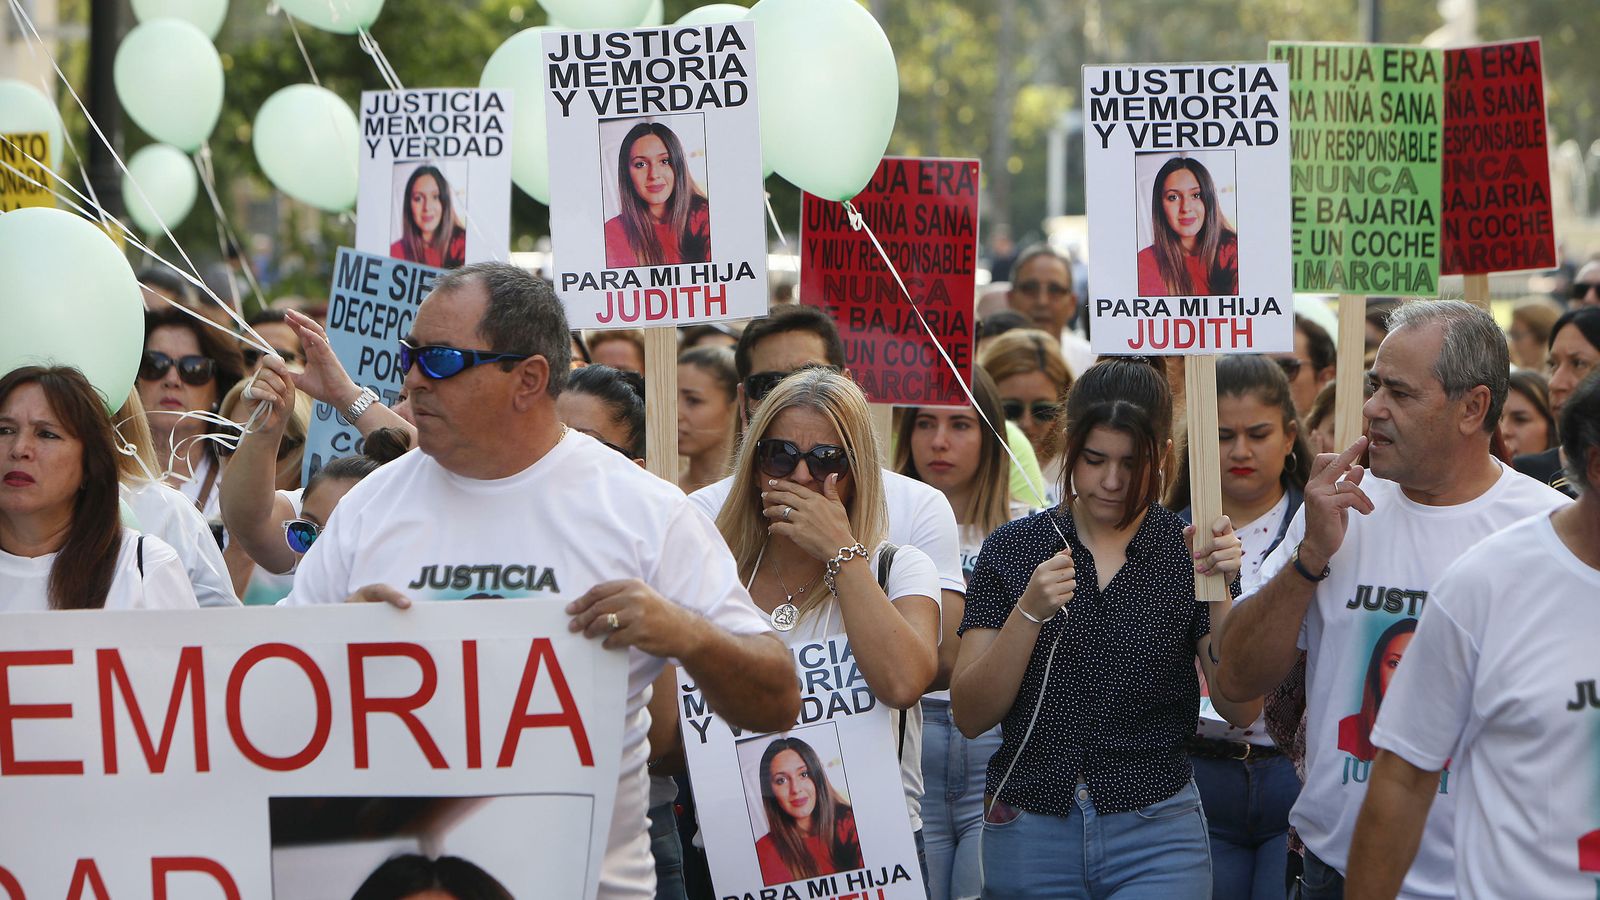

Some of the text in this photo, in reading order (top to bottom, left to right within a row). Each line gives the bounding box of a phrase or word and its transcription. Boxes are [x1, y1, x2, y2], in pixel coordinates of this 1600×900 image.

[548, 25, 746, 61] JUSTICIA
[549, 53, 747, 88] MEMORIA
[1312, 48, 1374, 82] HIJA
[1383, 50, 1438, 83] ERA
[1481, 44, 1539, 79] ERA
[1090, 67, 1279, 95] JUSTICIA
[366, 92, 504, 115] JUSTICIA
[552, 80, 748, 117] Y VERDAD
[1090, 94, 1279, 121] MEMORIA
[1324, 84, 1374, 122] NIÑA
[1380, 92, 1438, 124] SANA
[1482, 82, 1541, 117] SANA
[365, 114, 504, 136] MEMORIA
[1093, 121, 1279, 148] Y VERDAD
[366, 136, 503, 158] Y VERDAD
[1326, 130, 1437, 162] RESPONSABLE
[917, 162, 976, 196] ERA
[1291, 165, 1419, 195] NUNCA
[808, 199, 851, 232] UNA
[914, 204, 973, 237] SANA
[1317, 198, 1434, 226] BAJARIA
[1468, 210, 1550, 240] COCHE
[808, 239, 972, 275] Y MUY RESPONSABLE
[1311, 230, 1343, 256] UN
[1351, 231, 1435, 258] COCHE
[337, 252, 382, 296] ME
[561, 261, 756, 291] PARA MI HIJA
[1303, 260, 1434, 292] MARCHA
[596, 284, 727, 323] JUDITH
[824, 275, 952, 306] NUNCA
[331, 294, 417, 343] DECEPC
[850, 307, 968, 336] BAJARIA
[1096, 297, 1282, 317] PARA MI HIJA
[1127, 318, 1252, 349] JUDITH
[844, 339, 967, 369] UN COCHE
[408, 564, 560, 593] JUSTICIA
[689, 716, 713, 744] Y
[807, 876, 838, 899] MI
[846, 863, 911, 892] HIJA
